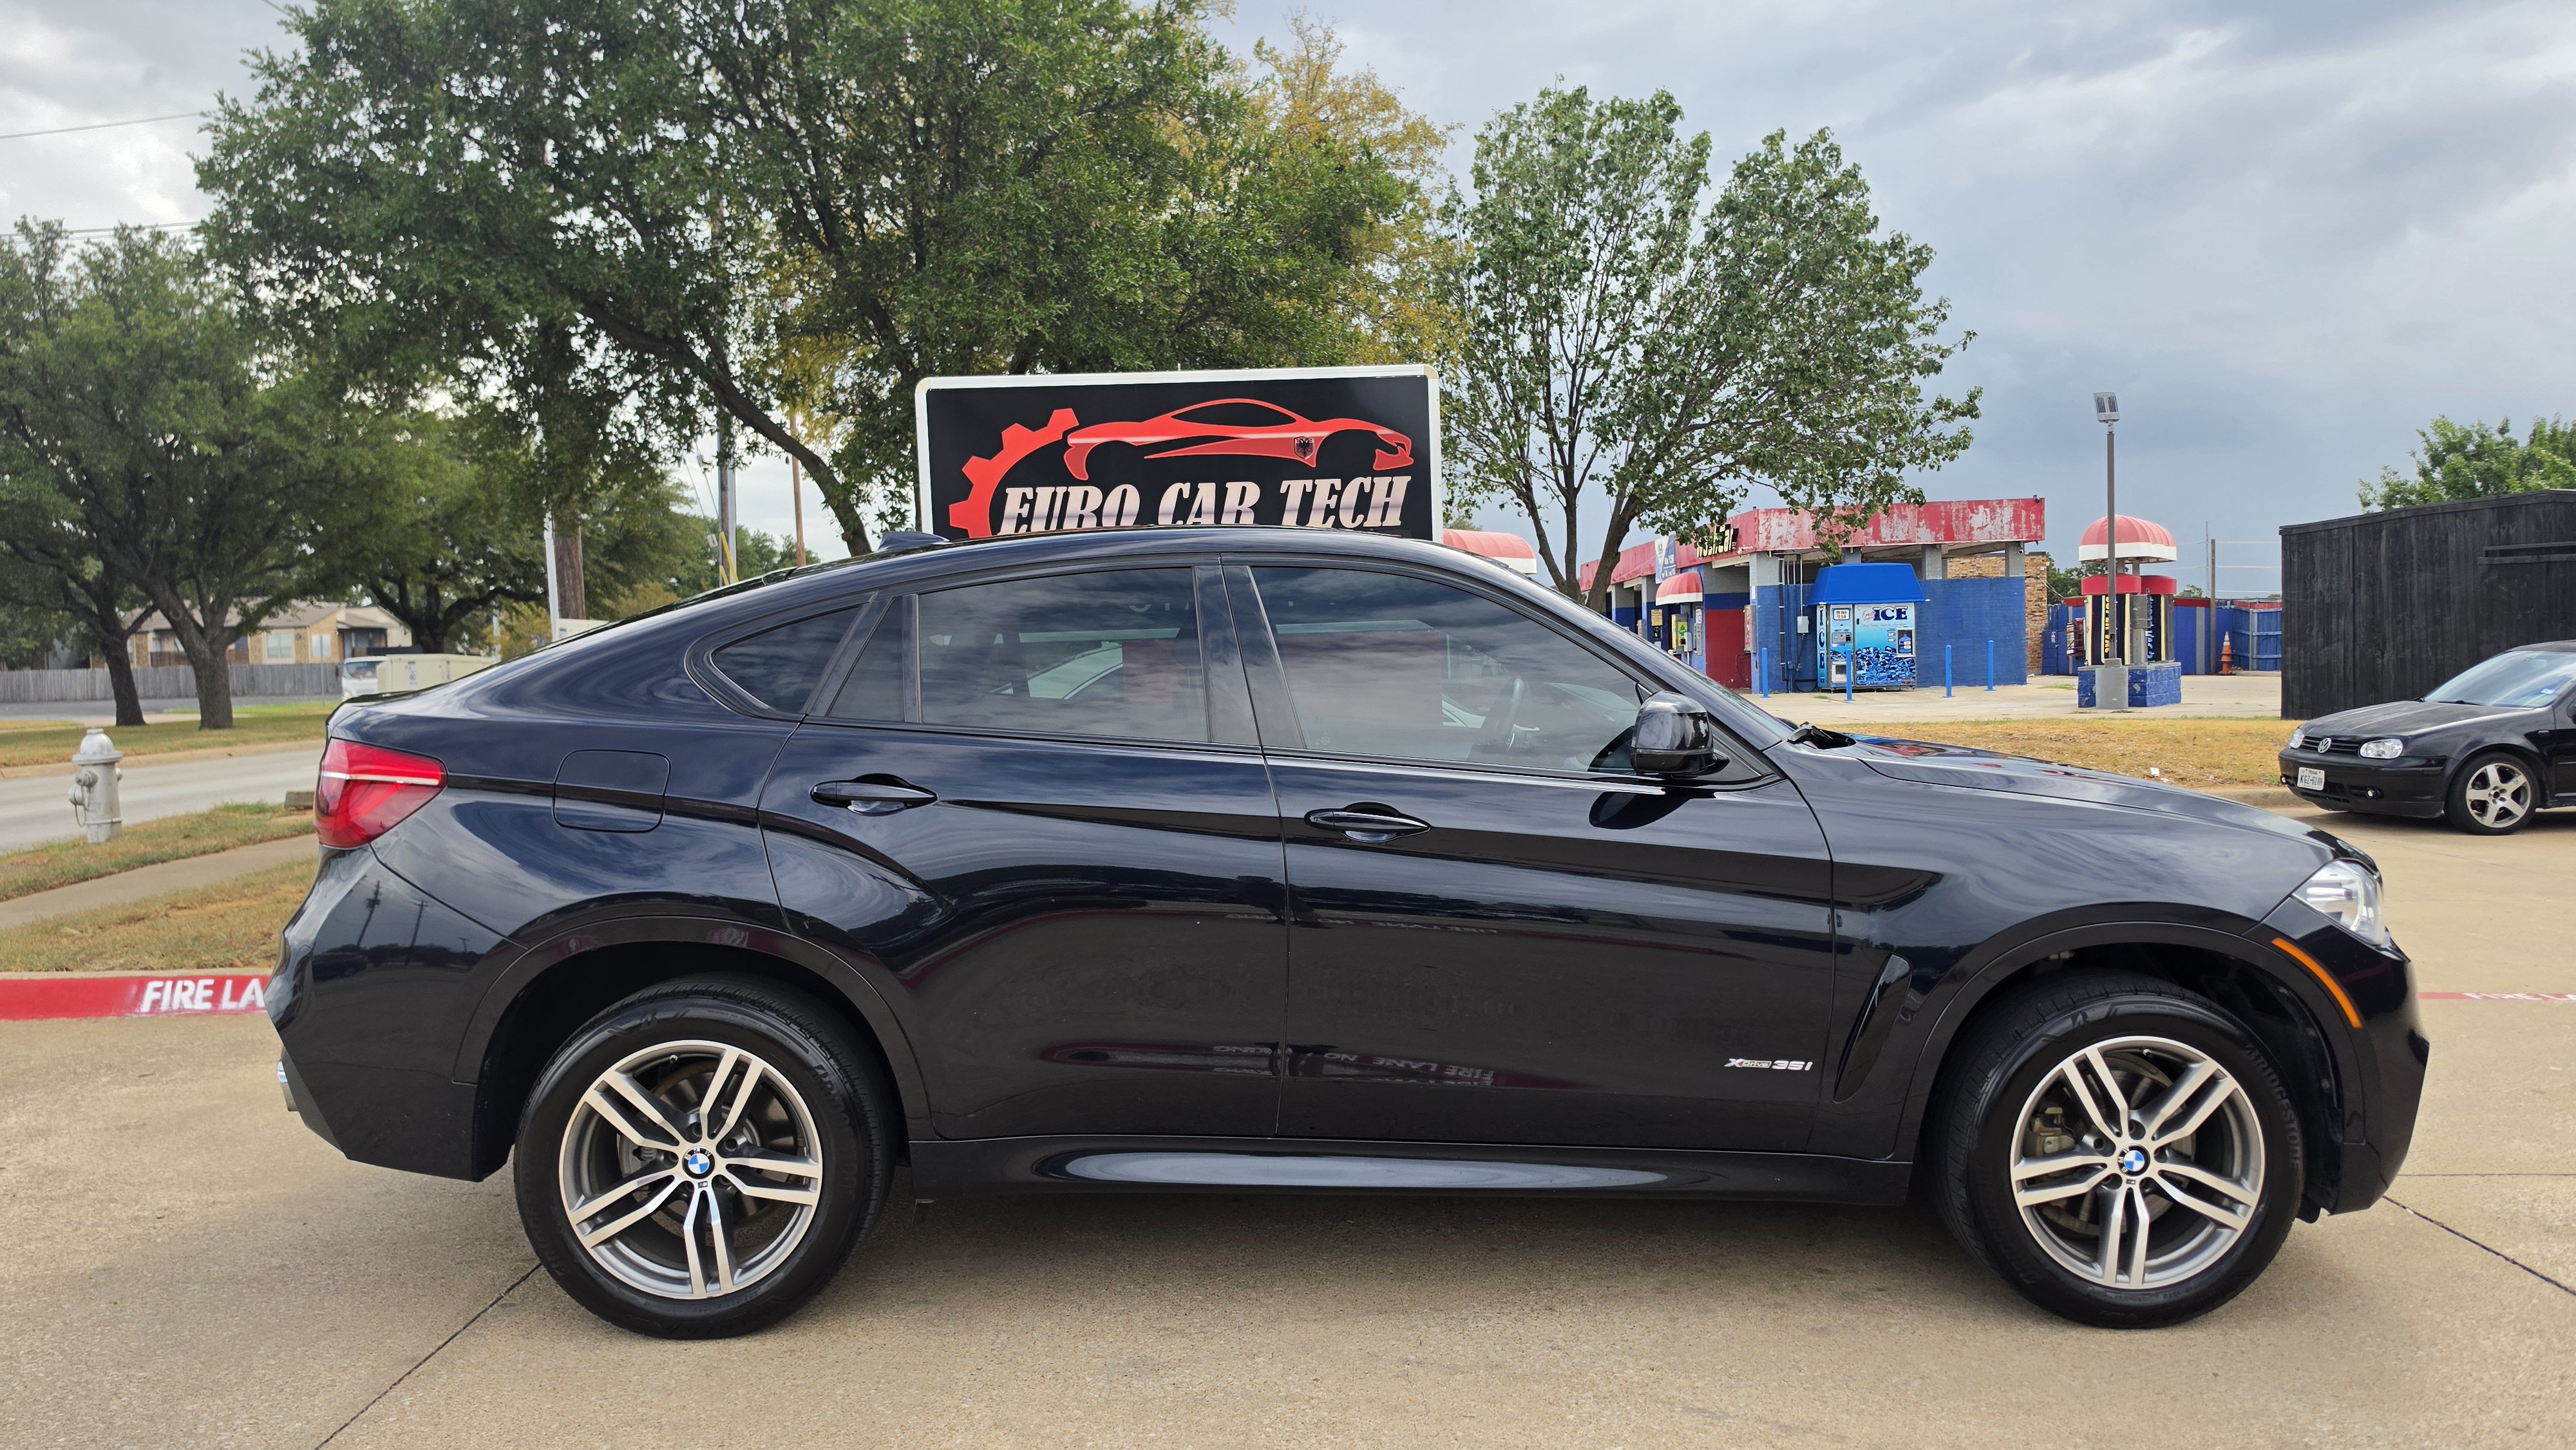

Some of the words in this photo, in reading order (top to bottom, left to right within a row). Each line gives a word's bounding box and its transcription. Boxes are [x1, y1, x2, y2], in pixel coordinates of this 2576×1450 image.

[998, 484, 1141, 535] EURO
[1158, 480, 1262, 525] CAR
[1279, 475, 1412, 529] TECH
[1873, 606, 1908, 621] ICE
[140, 979, 215, 1013] FIRE
